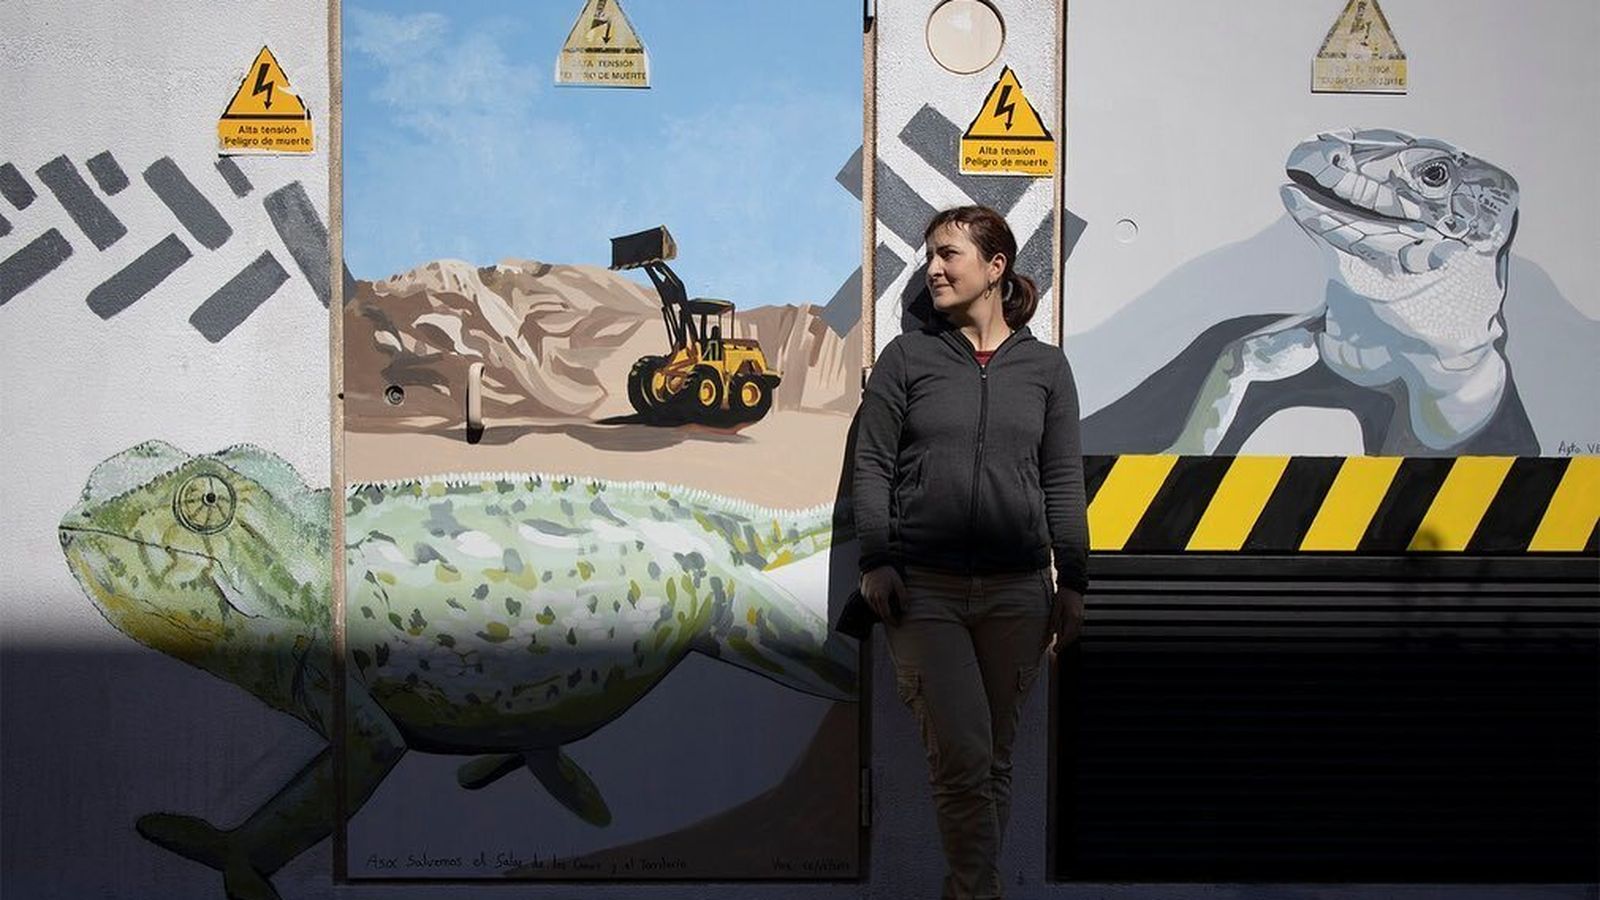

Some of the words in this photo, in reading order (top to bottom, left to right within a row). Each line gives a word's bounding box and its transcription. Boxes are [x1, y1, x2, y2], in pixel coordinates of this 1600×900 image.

[238, 125, 259, 134] Alta
[261, 125, 297, 134] tensión
[224, 137, 259, 147] Peligro
[261, 137, 274, 146] de
[275, 138, 311, 146] muerte
[979, 146, 998, 155] Alta
[1001, 146, 1036, 155] tensión
[965, 157, 998, 168] Peligro
[1000, 158, 1013, 166] de
[1014, 158, 1049, 167] muerte
